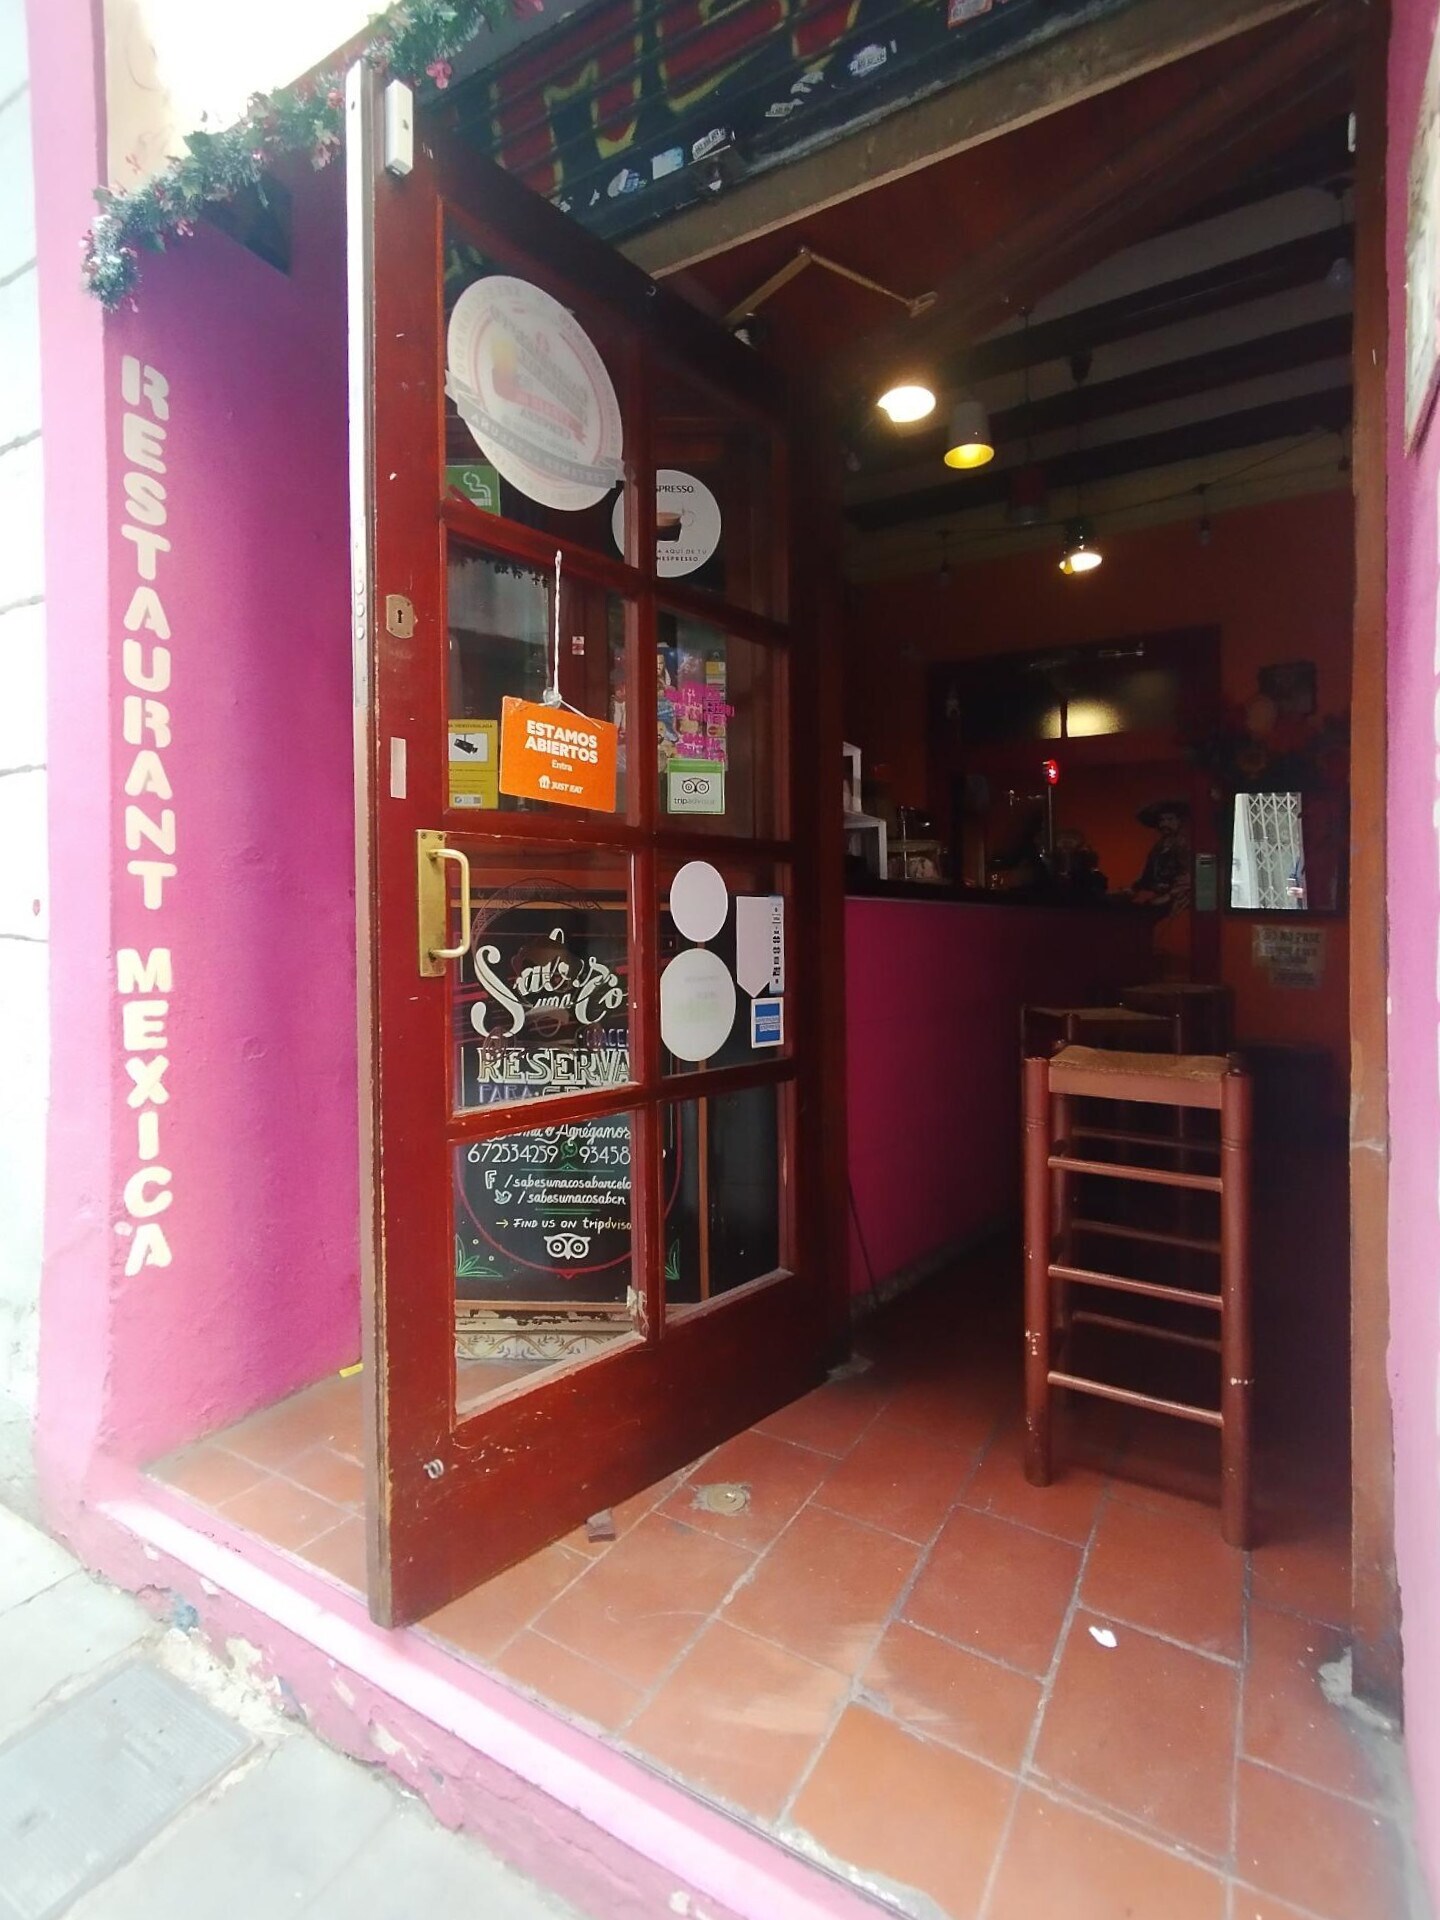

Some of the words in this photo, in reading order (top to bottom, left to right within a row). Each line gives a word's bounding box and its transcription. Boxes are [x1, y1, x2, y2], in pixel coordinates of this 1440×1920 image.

[121, 355, 178, 910] RESTAURANT
[526, 719, 598, 749] ESTAMOS
[524, 735, 599, 764] ABIERTOS
[551, 759, 573, 772] Entra
[551, 781, 569, 792] JUST
[569, 785, 584, 794] EAT
[554, 1121, 632, 1147] Agréganos
[467, 1143, 559, 1163] 672534259
[513, 1218, 538, 1228] FIND
[541, 1218, 556, 1228] US
[560, 1219, 577, 1228] ON
